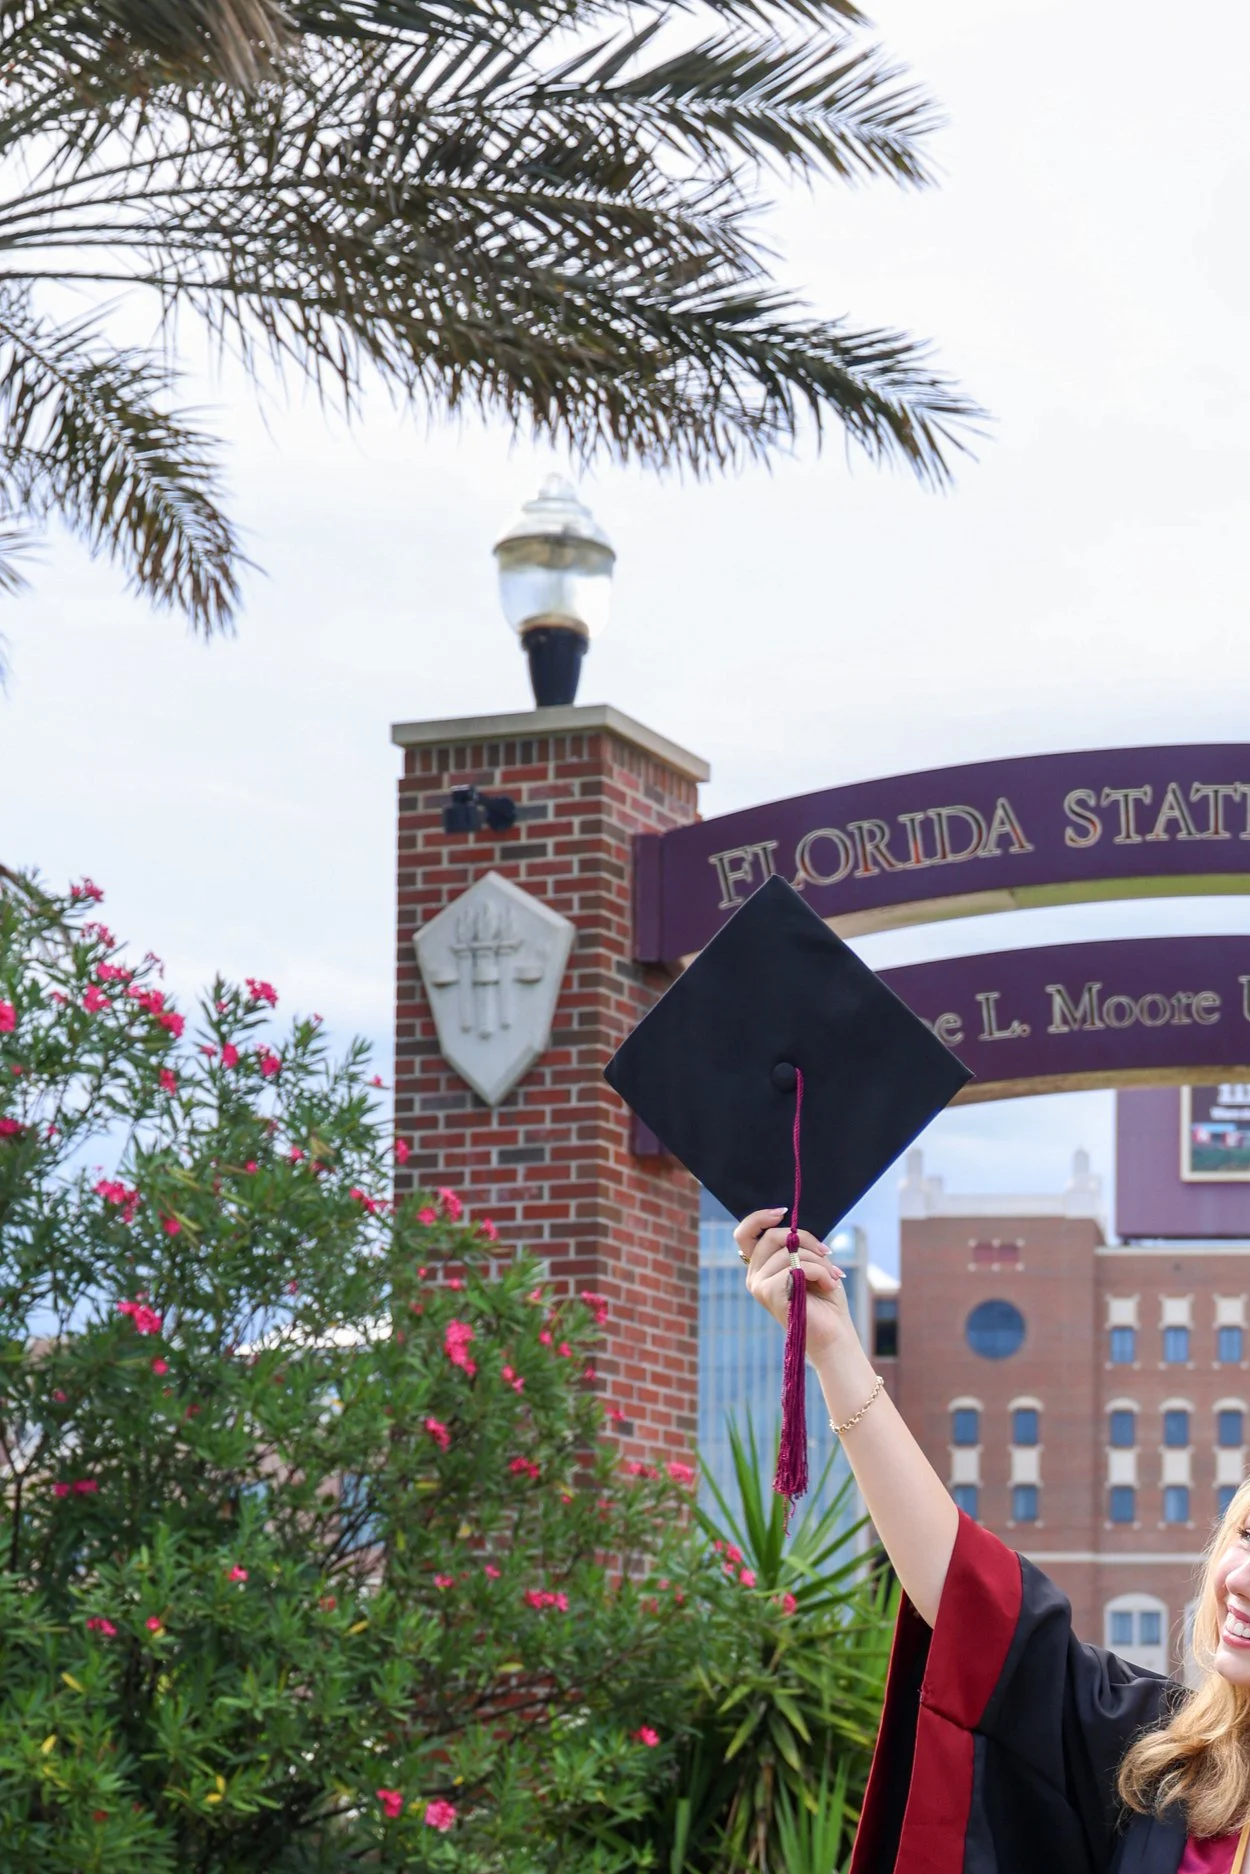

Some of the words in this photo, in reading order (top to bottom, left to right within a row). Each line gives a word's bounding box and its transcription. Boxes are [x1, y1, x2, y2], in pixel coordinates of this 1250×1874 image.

[708, 798, 1034, 910] FLORIDA
[975, 991, 1031, 1041] L.
[1045, 981, 1221, 1034] Moore
